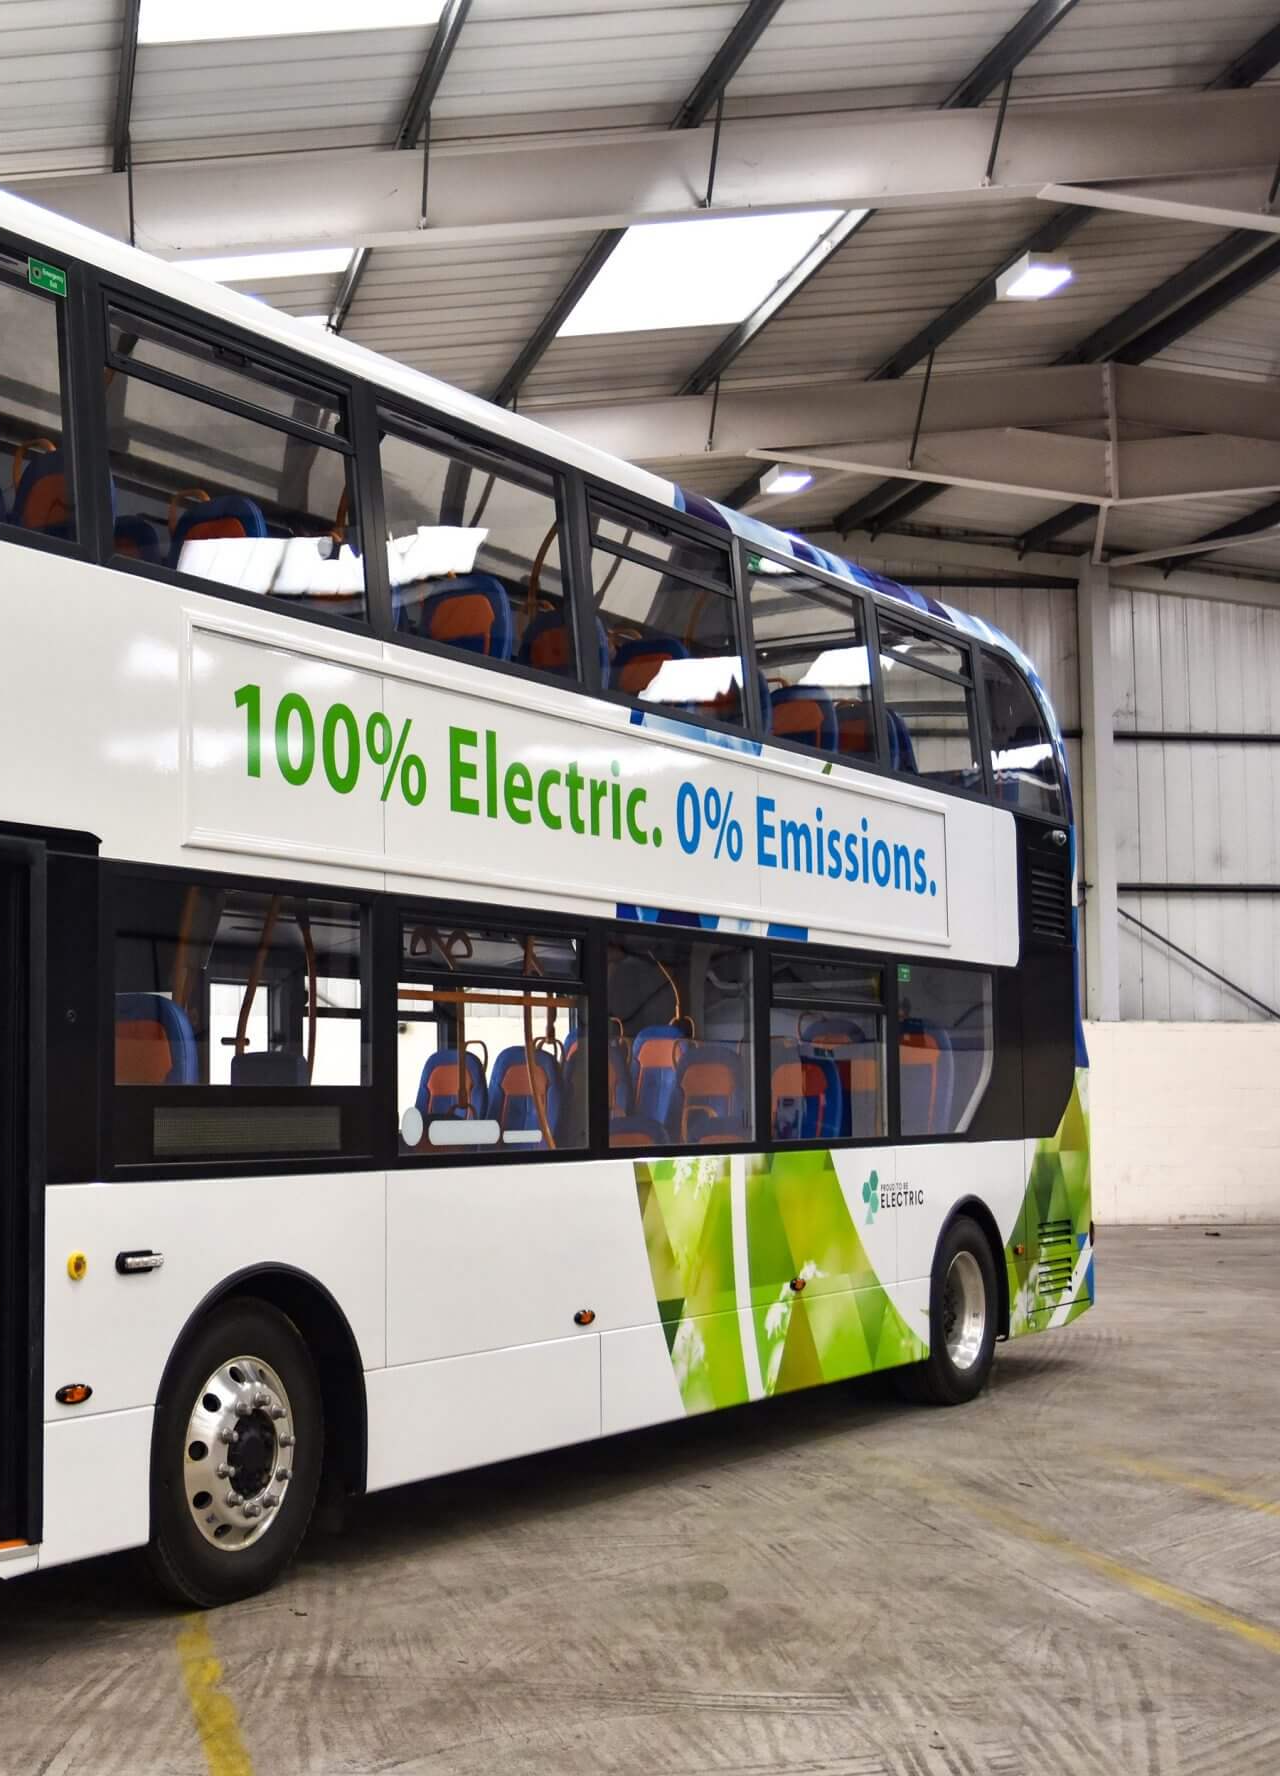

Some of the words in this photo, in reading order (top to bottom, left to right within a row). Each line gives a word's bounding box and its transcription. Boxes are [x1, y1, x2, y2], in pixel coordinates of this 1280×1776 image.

[234, 684, 427, 807] 100%
[449, 726, 663, 848] Electric.
[676, 781, 743, 862] 0%
[756, 796, 937, 897] Emissions.
[880, 1189, 924, 1209] ELECTRIC
